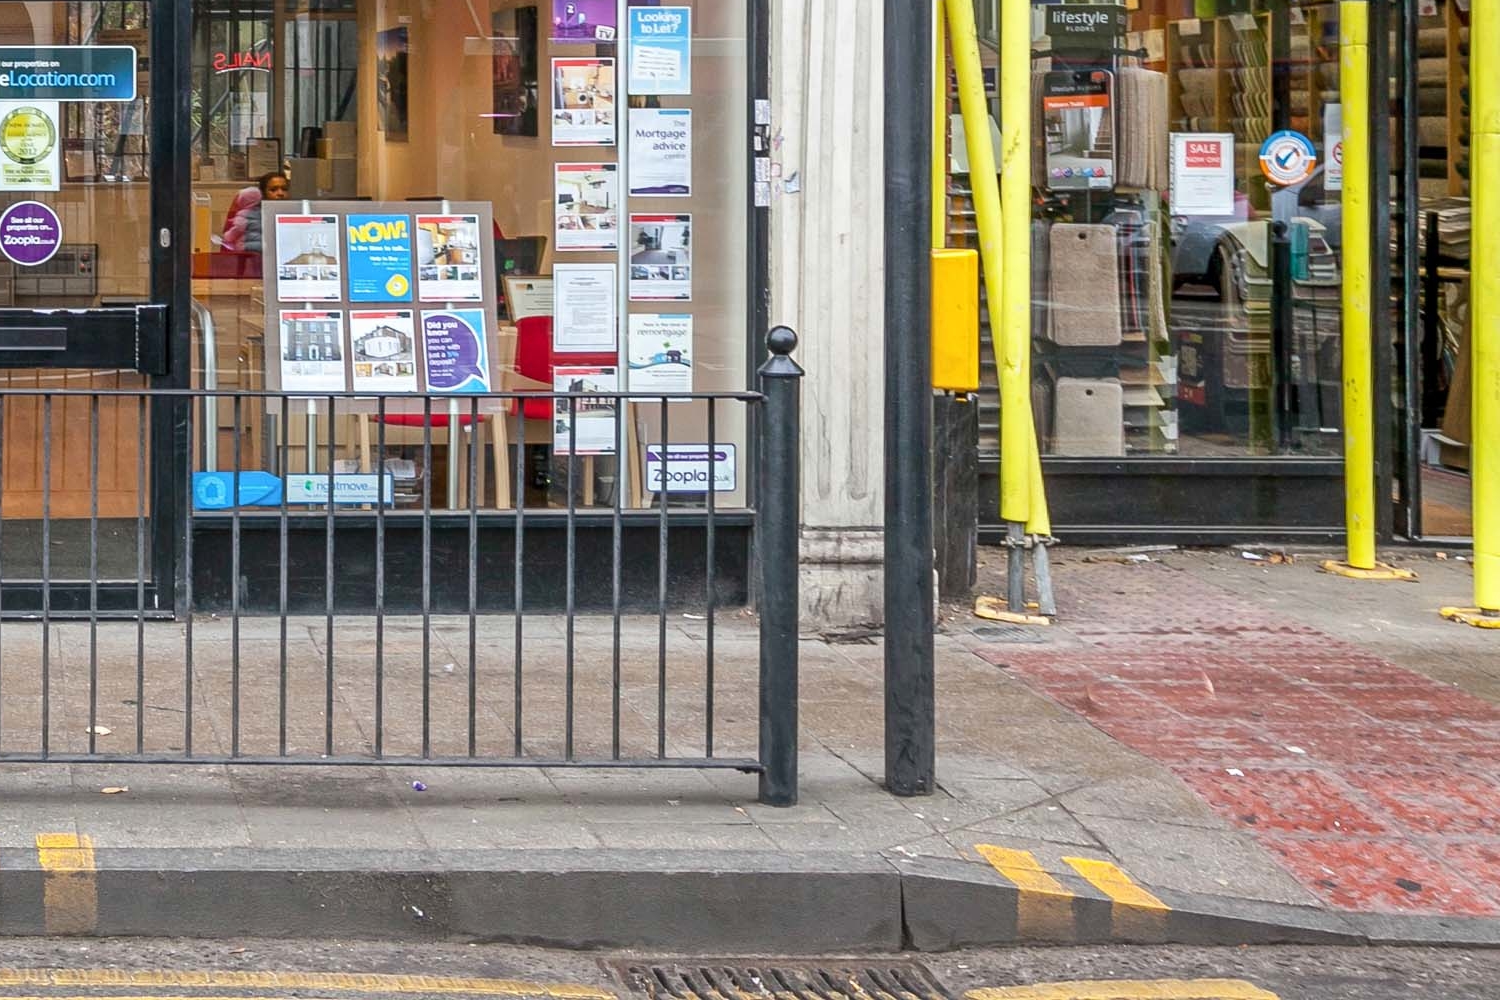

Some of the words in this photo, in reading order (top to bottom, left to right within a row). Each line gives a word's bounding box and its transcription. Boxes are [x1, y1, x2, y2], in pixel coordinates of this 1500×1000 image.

[637, 12, 682, 25] Looking
[1052, 10, 1109, 25] lifestyle
[640, 23, 653, 34] to
[654, 23, 679, 34] Let?
[14, 60, 49, 70] properties
[636, 129, 687, 140] Mortgage
[652, 141, 686, 151] advice
[1190, 143, 1218, 154] SALE
[349, 220, 408, 244] NOW!
[426, 321, 441, 329] Did
